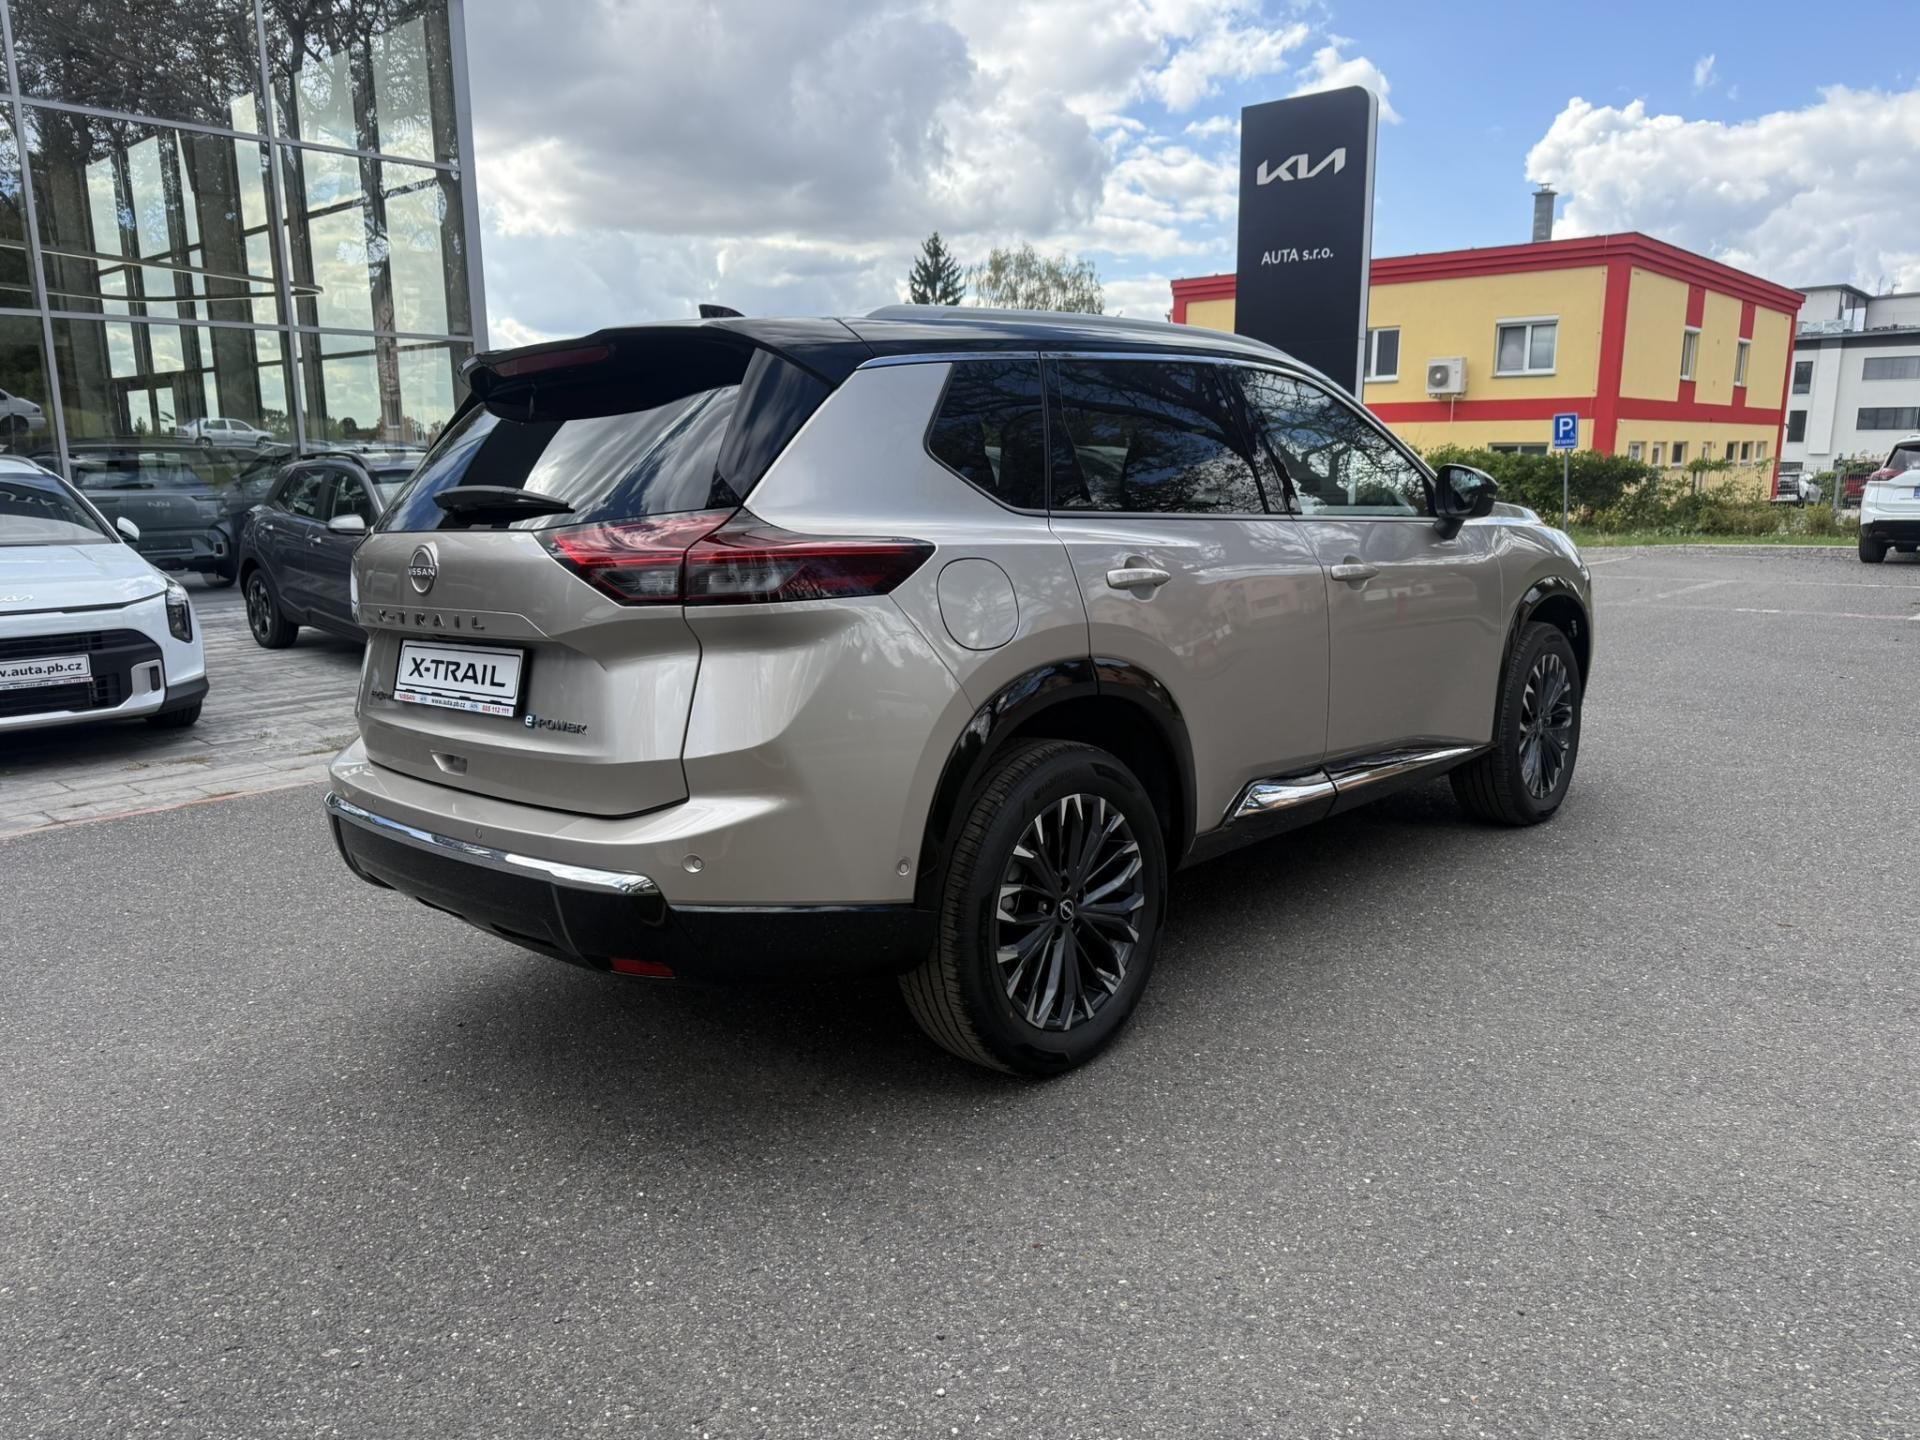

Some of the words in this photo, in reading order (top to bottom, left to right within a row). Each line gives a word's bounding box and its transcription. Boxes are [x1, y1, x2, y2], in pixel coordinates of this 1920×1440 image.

[1257, 147, 1346, 186] KIA
[1261, 248, 1299, 266] AUTA
[1302, 247, 1334, 261] s.r.o.
[1559, 418, 1574, 438] P
[379, 608, 486, 631] X-TRAIL
[408, 656, 507, 688] X-TRAIL
